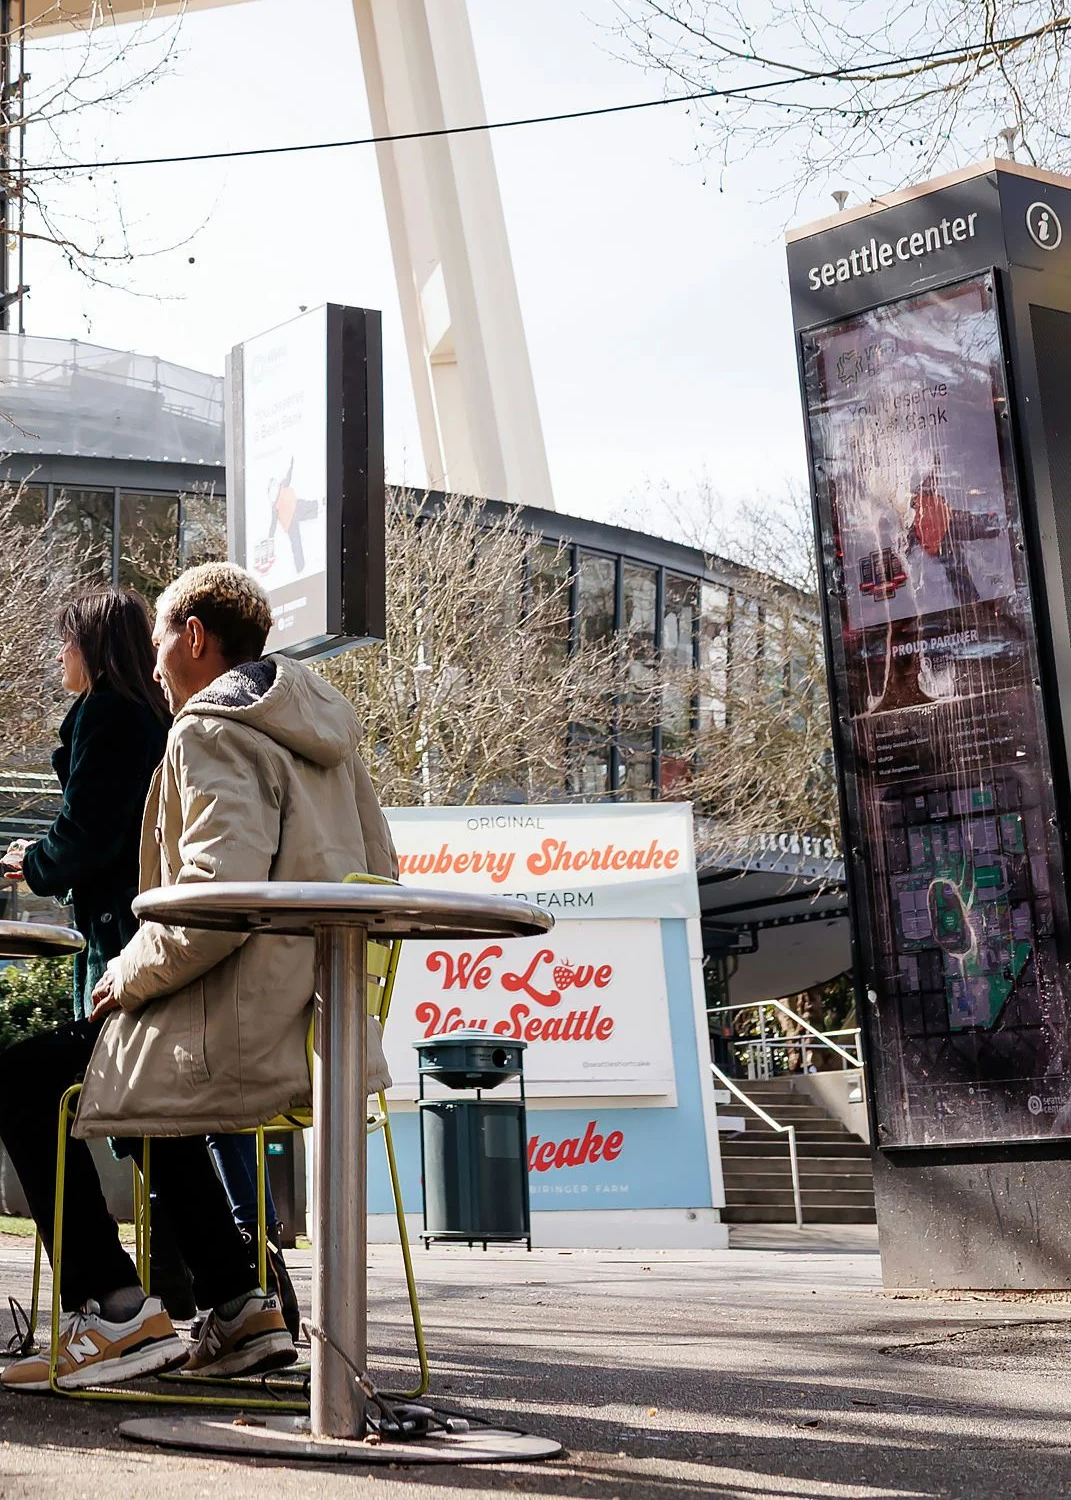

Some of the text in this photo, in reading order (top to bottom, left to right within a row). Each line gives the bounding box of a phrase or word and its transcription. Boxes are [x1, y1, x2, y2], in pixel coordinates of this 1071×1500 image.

[905, 407, 948, 433] Bank
[892, 629, 978, 658] PROUD PARTNER
[466, 816, 545, 831] ORIGINAL
[398, 843, 516, 884] awberry
[526, 837, 680, 876] Shortcake
[536, 891, 595, 908] FARM
[426, 945, 503, 990] We
[493, 1003, 614, 1042] Seattle
[528, 1120, 624, 1173] tcake
[529, 1183, 629, 1194] BIRINGER FARM
